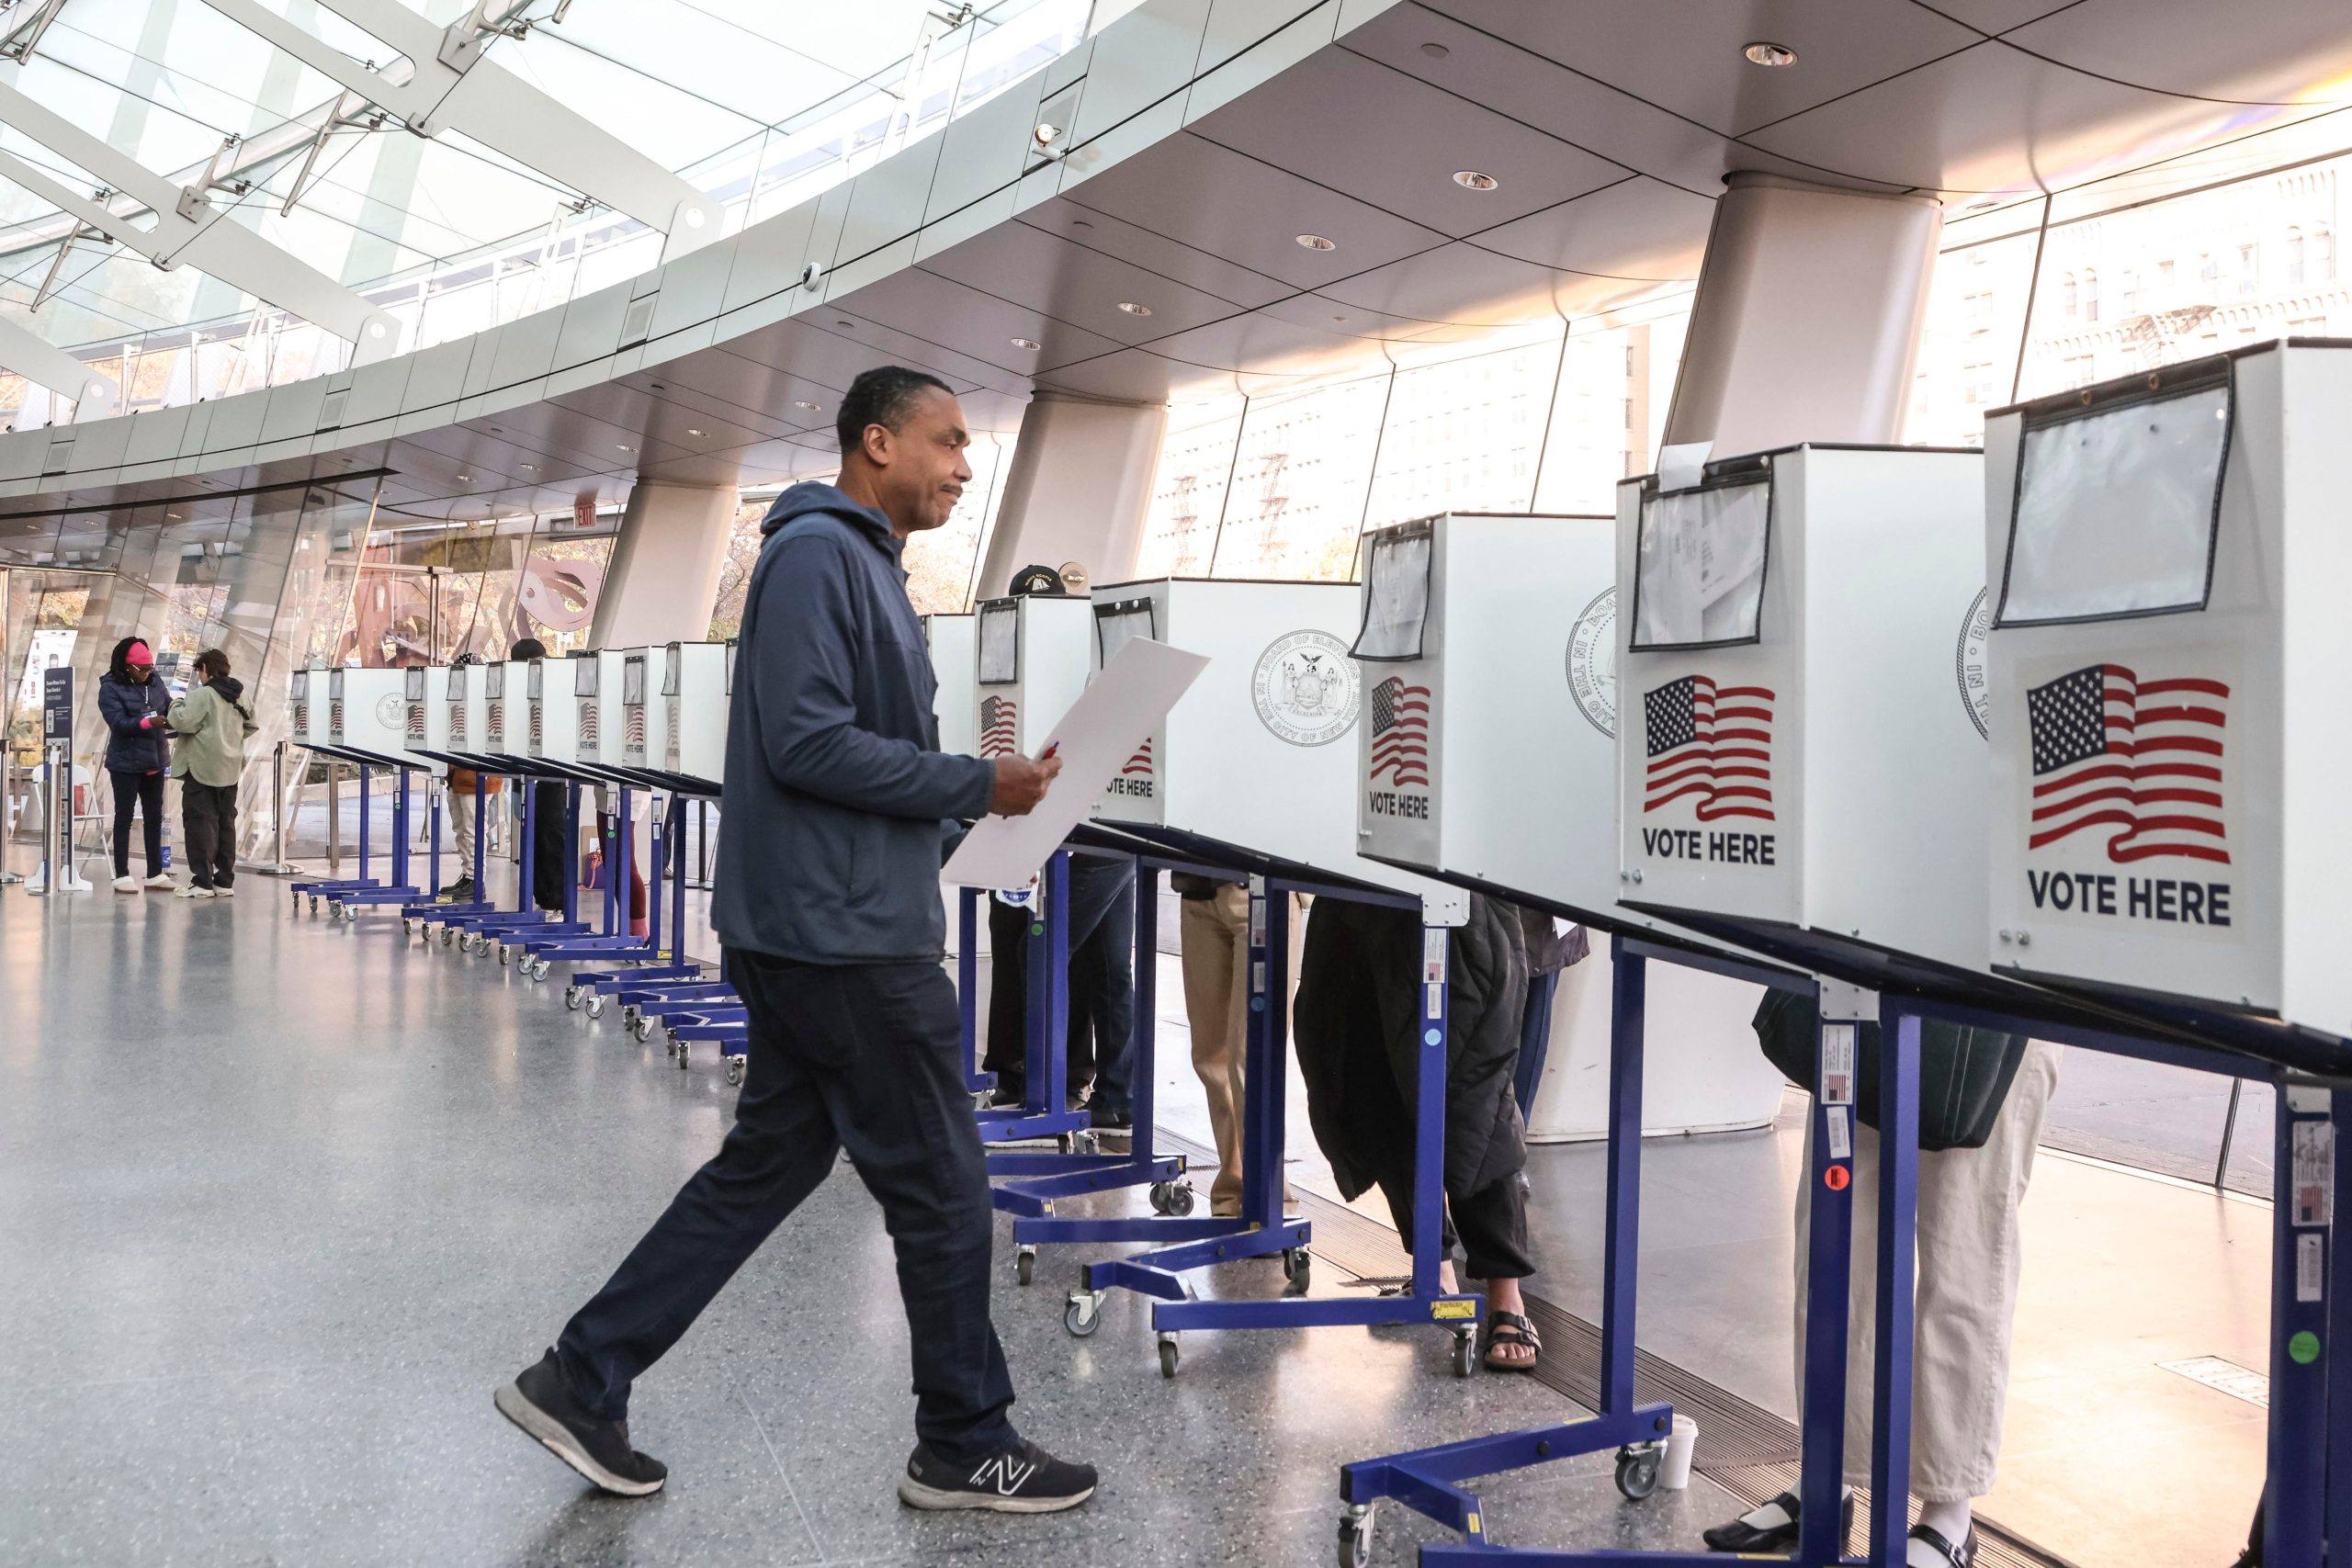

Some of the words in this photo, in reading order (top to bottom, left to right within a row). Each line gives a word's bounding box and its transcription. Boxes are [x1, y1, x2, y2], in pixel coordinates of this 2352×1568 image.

[578, 505, 593, 526] EXIT
[1586, 598, 1616, 627] BOA
[1261, 639, 1292, 671] BOARD
[1294, 634, 1309, 644] OF
[1573, 639, 1589, 659] IN
[1256, 682, 1265, 695] IN
[1574, 664, 1592, 698] THE
[1966, 664, 1984, 689] IN
[1258, 697, 1275, 722] THE
[1272, 720, 1299, 739] CITY
[1301, 732, 1317, 742] OF
[1319, 721, 1344, 740] NEW
[1126, 779, 1153, 798] HERE
[1369, 791, 1396, 816] VOTE
[1398, 795, 1429, 820] HERE
[1643, 828, 1702, 860] VOTE
[1709, 831, 1775, 865] HERE
[2027, 869, 2117, 916] VOTE
[2129, 876, 2232, 927] HERE
